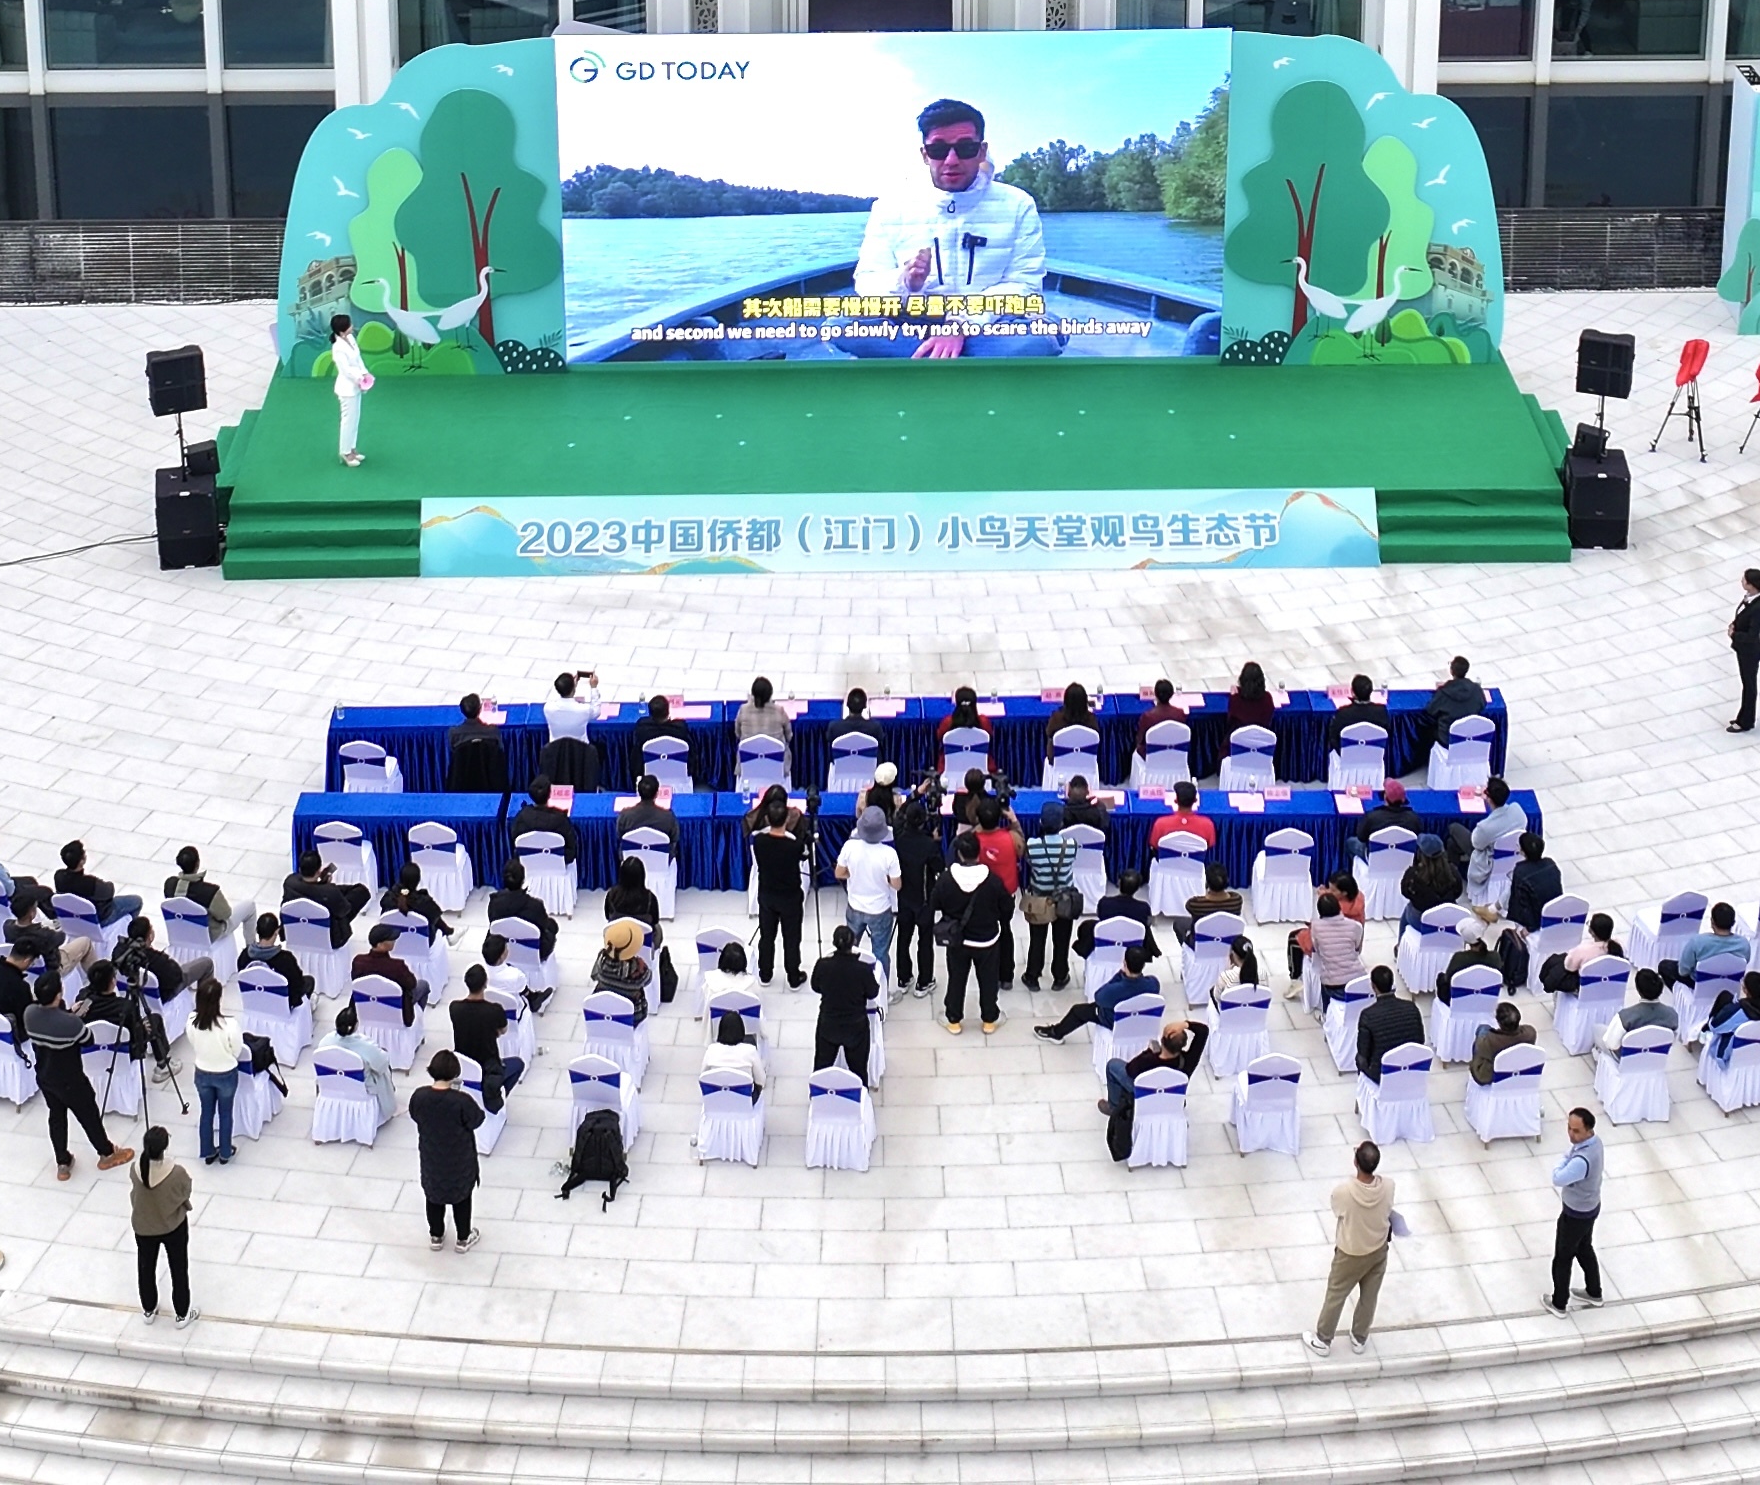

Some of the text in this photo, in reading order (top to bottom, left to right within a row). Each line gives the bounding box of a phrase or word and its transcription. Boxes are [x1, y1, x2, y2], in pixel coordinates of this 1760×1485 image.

[615, 61, 656, 81] GD
[661, 60, 751, 81] TODAY
[742, 295, 1046, 318] 其次船需要慢慢开 尽量不要吓跑鸟
[631, 318, 1152, 341] and second we need to go slowly try not to scare the birds away
[518, 512, 1281, 555] 2023中国侨都（江门）小鸟天堂观鸟生态节
